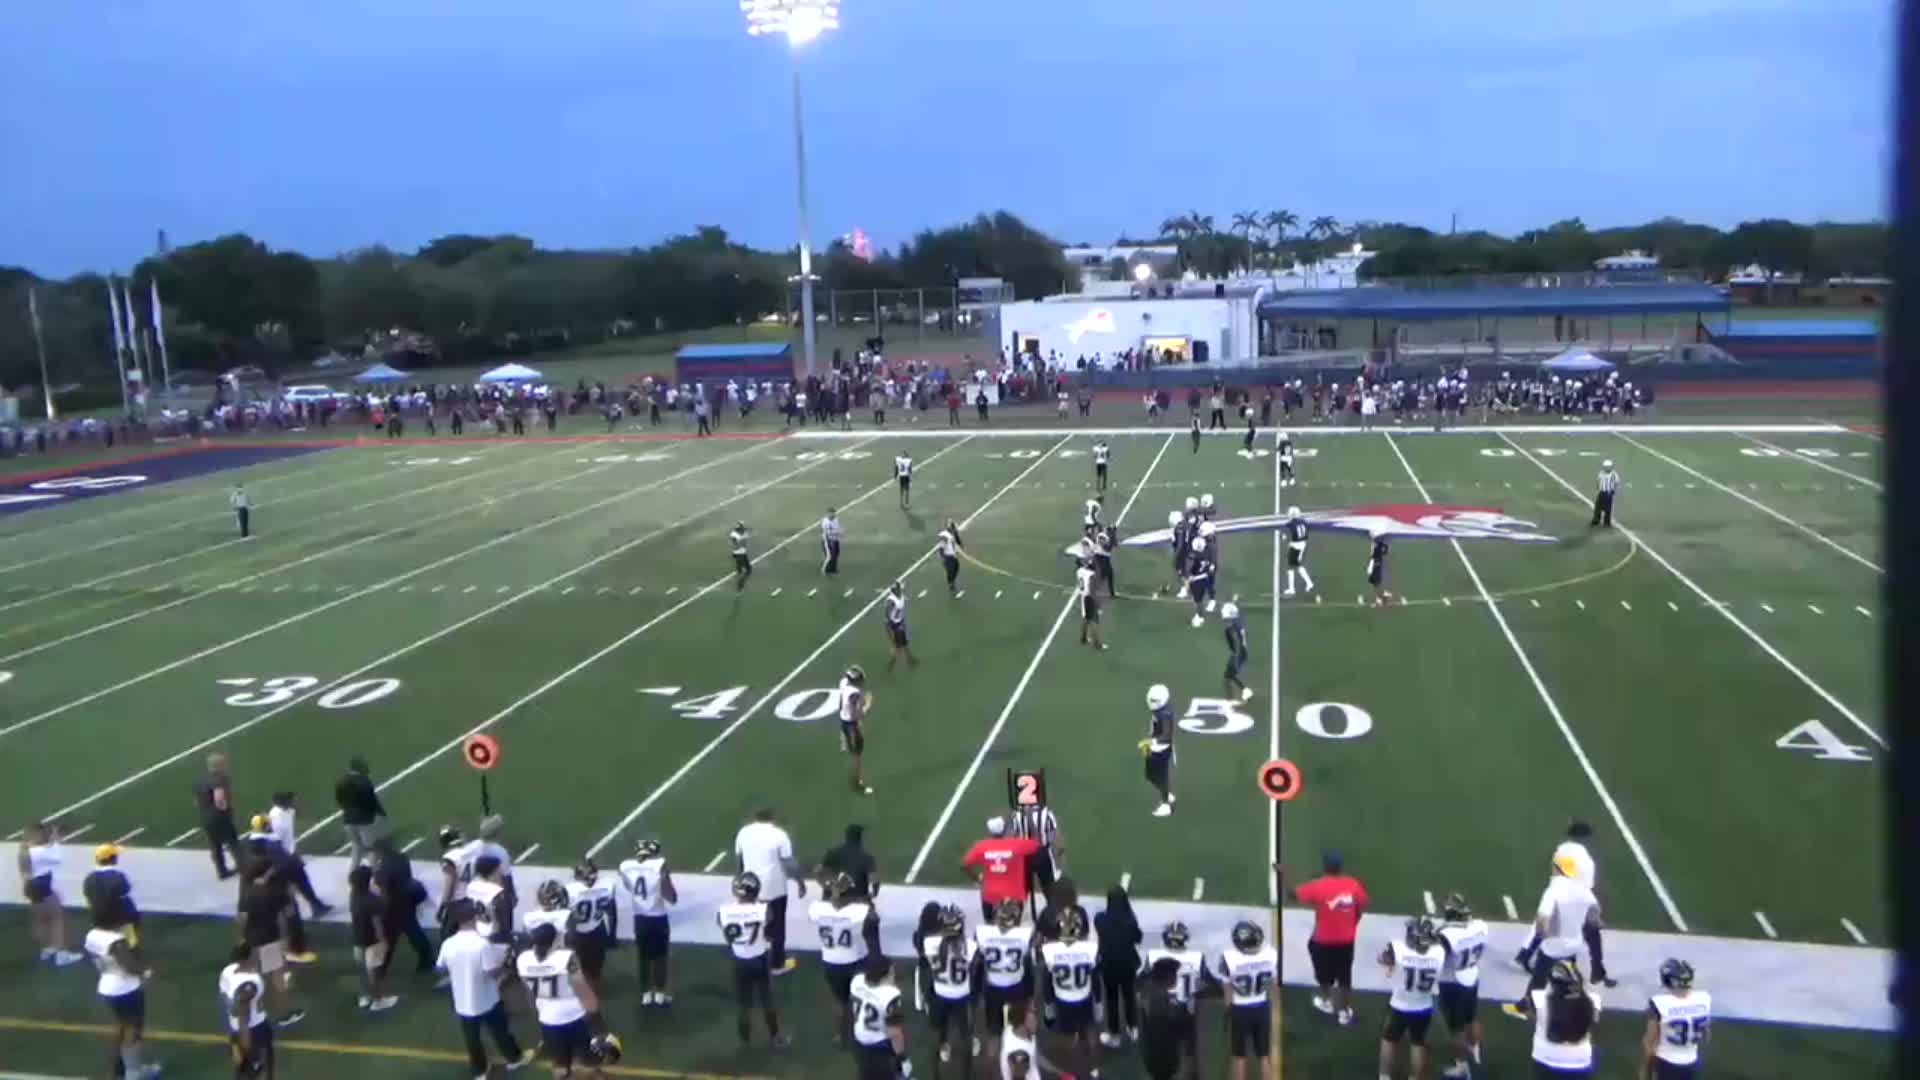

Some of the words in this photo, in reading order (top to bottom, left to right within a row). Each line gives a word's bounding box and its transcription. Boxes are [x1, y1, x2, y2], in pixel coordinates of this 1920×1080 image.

[1016, 774, 1038, 805] 2
[634, 875, 648, 902] 4
[724, 921, 763, 946] 27
[818, 925, 852, 949] 54
[984, 946, 1024, 975] 23
[1052, 963, 1092, 992] 20
[1403, 966, 1437, 993] 15
[1665, 1016, 1710, 1047] 35
